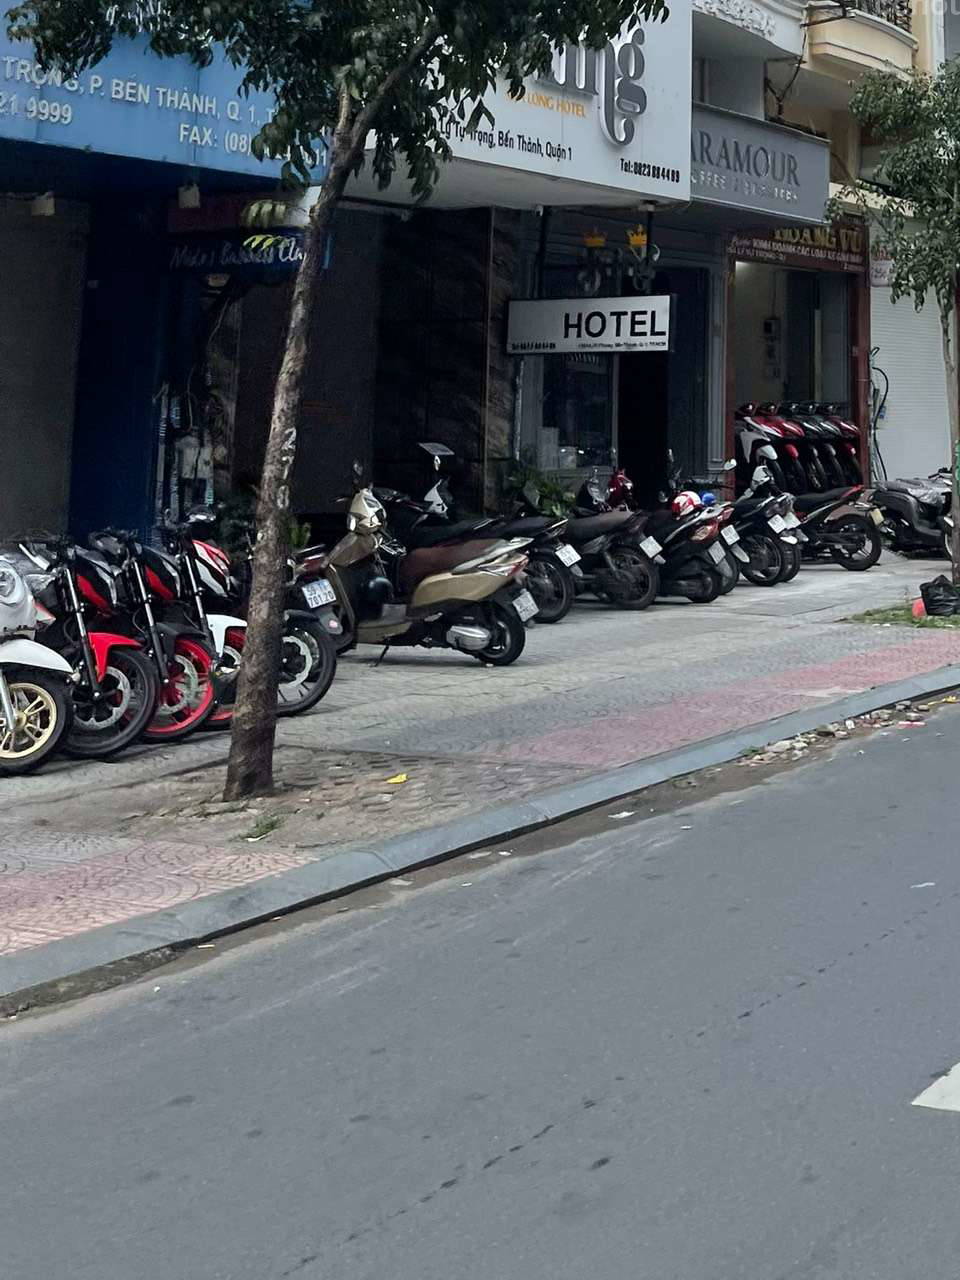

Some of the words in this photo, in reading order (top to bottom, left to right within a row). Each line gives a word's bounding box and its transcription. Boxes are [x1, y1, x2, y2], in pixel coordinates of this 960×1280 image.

[27, 97, 72, 124] 9999
[528, 92, 553, 110] LONG
[555, 99, 586, 117] HOTEL
[179, 124, 217, 147] FAX:
[563, 310, 667, 339] HOTEL
